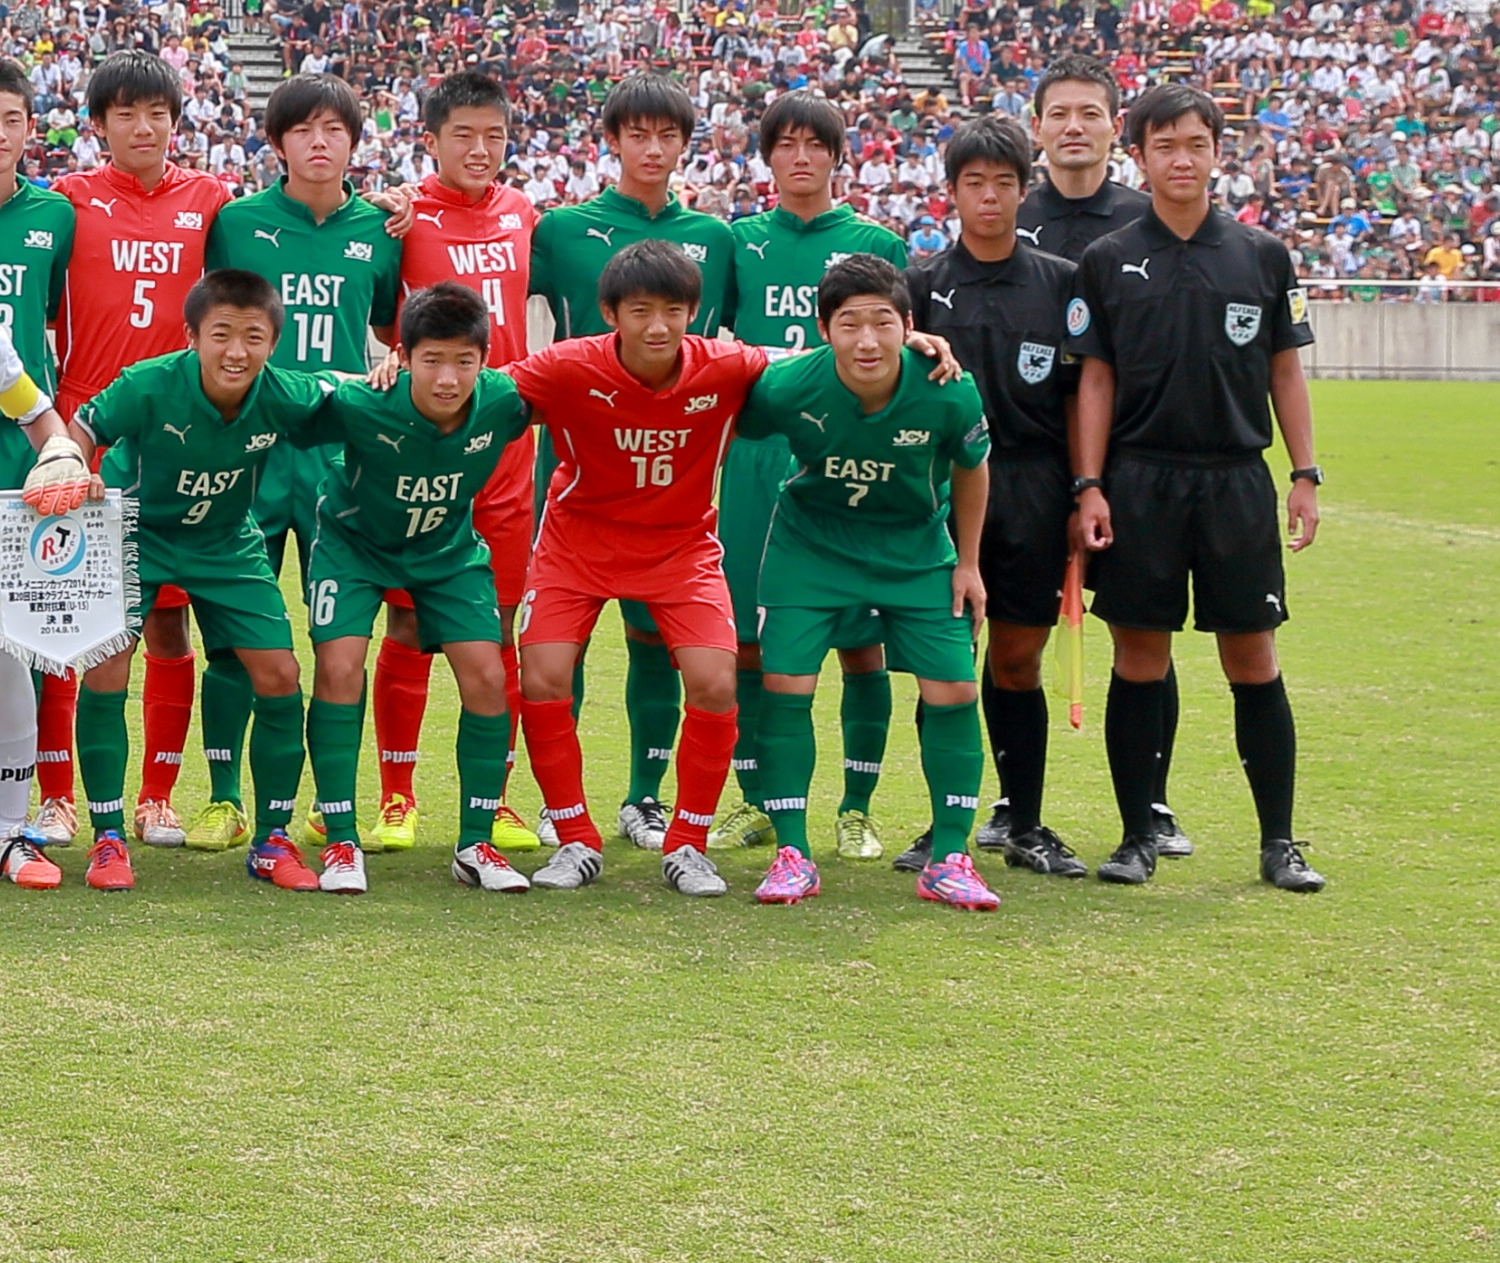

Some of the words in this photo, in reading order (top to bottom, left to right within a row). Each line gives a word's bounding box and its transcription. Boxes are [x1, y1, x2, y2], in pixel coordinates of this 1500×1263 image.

[174, 211, 203, 230] JCY
[23, 230, 53, 249] JCY
[110, 240, 184, 273] WEST
[344, 241, 372, 261] JCY
[447, 241, 518, 275] WEST
[280, 274, 345, 307] EAST
[130, 280, 156, 328] 5
[292, 312, 334, 363] 14
[684, 394, 717, 414] JCY
[245, 432, 276, 452] JCY
[464, 432, 492, 454] JCY
[614, 428, 692, 453] WEST
[893, 429, 930, 446] JCY
[629, 455, 674, 488] 16
[825, 457, 895, 482] EAST
[176, 468, 245, 496] EAST
[395, 473, 464, 502] EAST
[844, 484, 869, 507] 7
[182, 499, 212, 525] 9
[402, 506, 447, 538] 16
[23, 580, 86, 590] メニコンカップ2014
[40, 626, 79, 635] 2014.9.15
[37, 749, 70, 763] UMA
[382, 750, 417, 763] PUM
[0, 766, 35, 782] PUM
[764, 797, 805, 811] PUM
[679, 809, 714, 826] PUM
